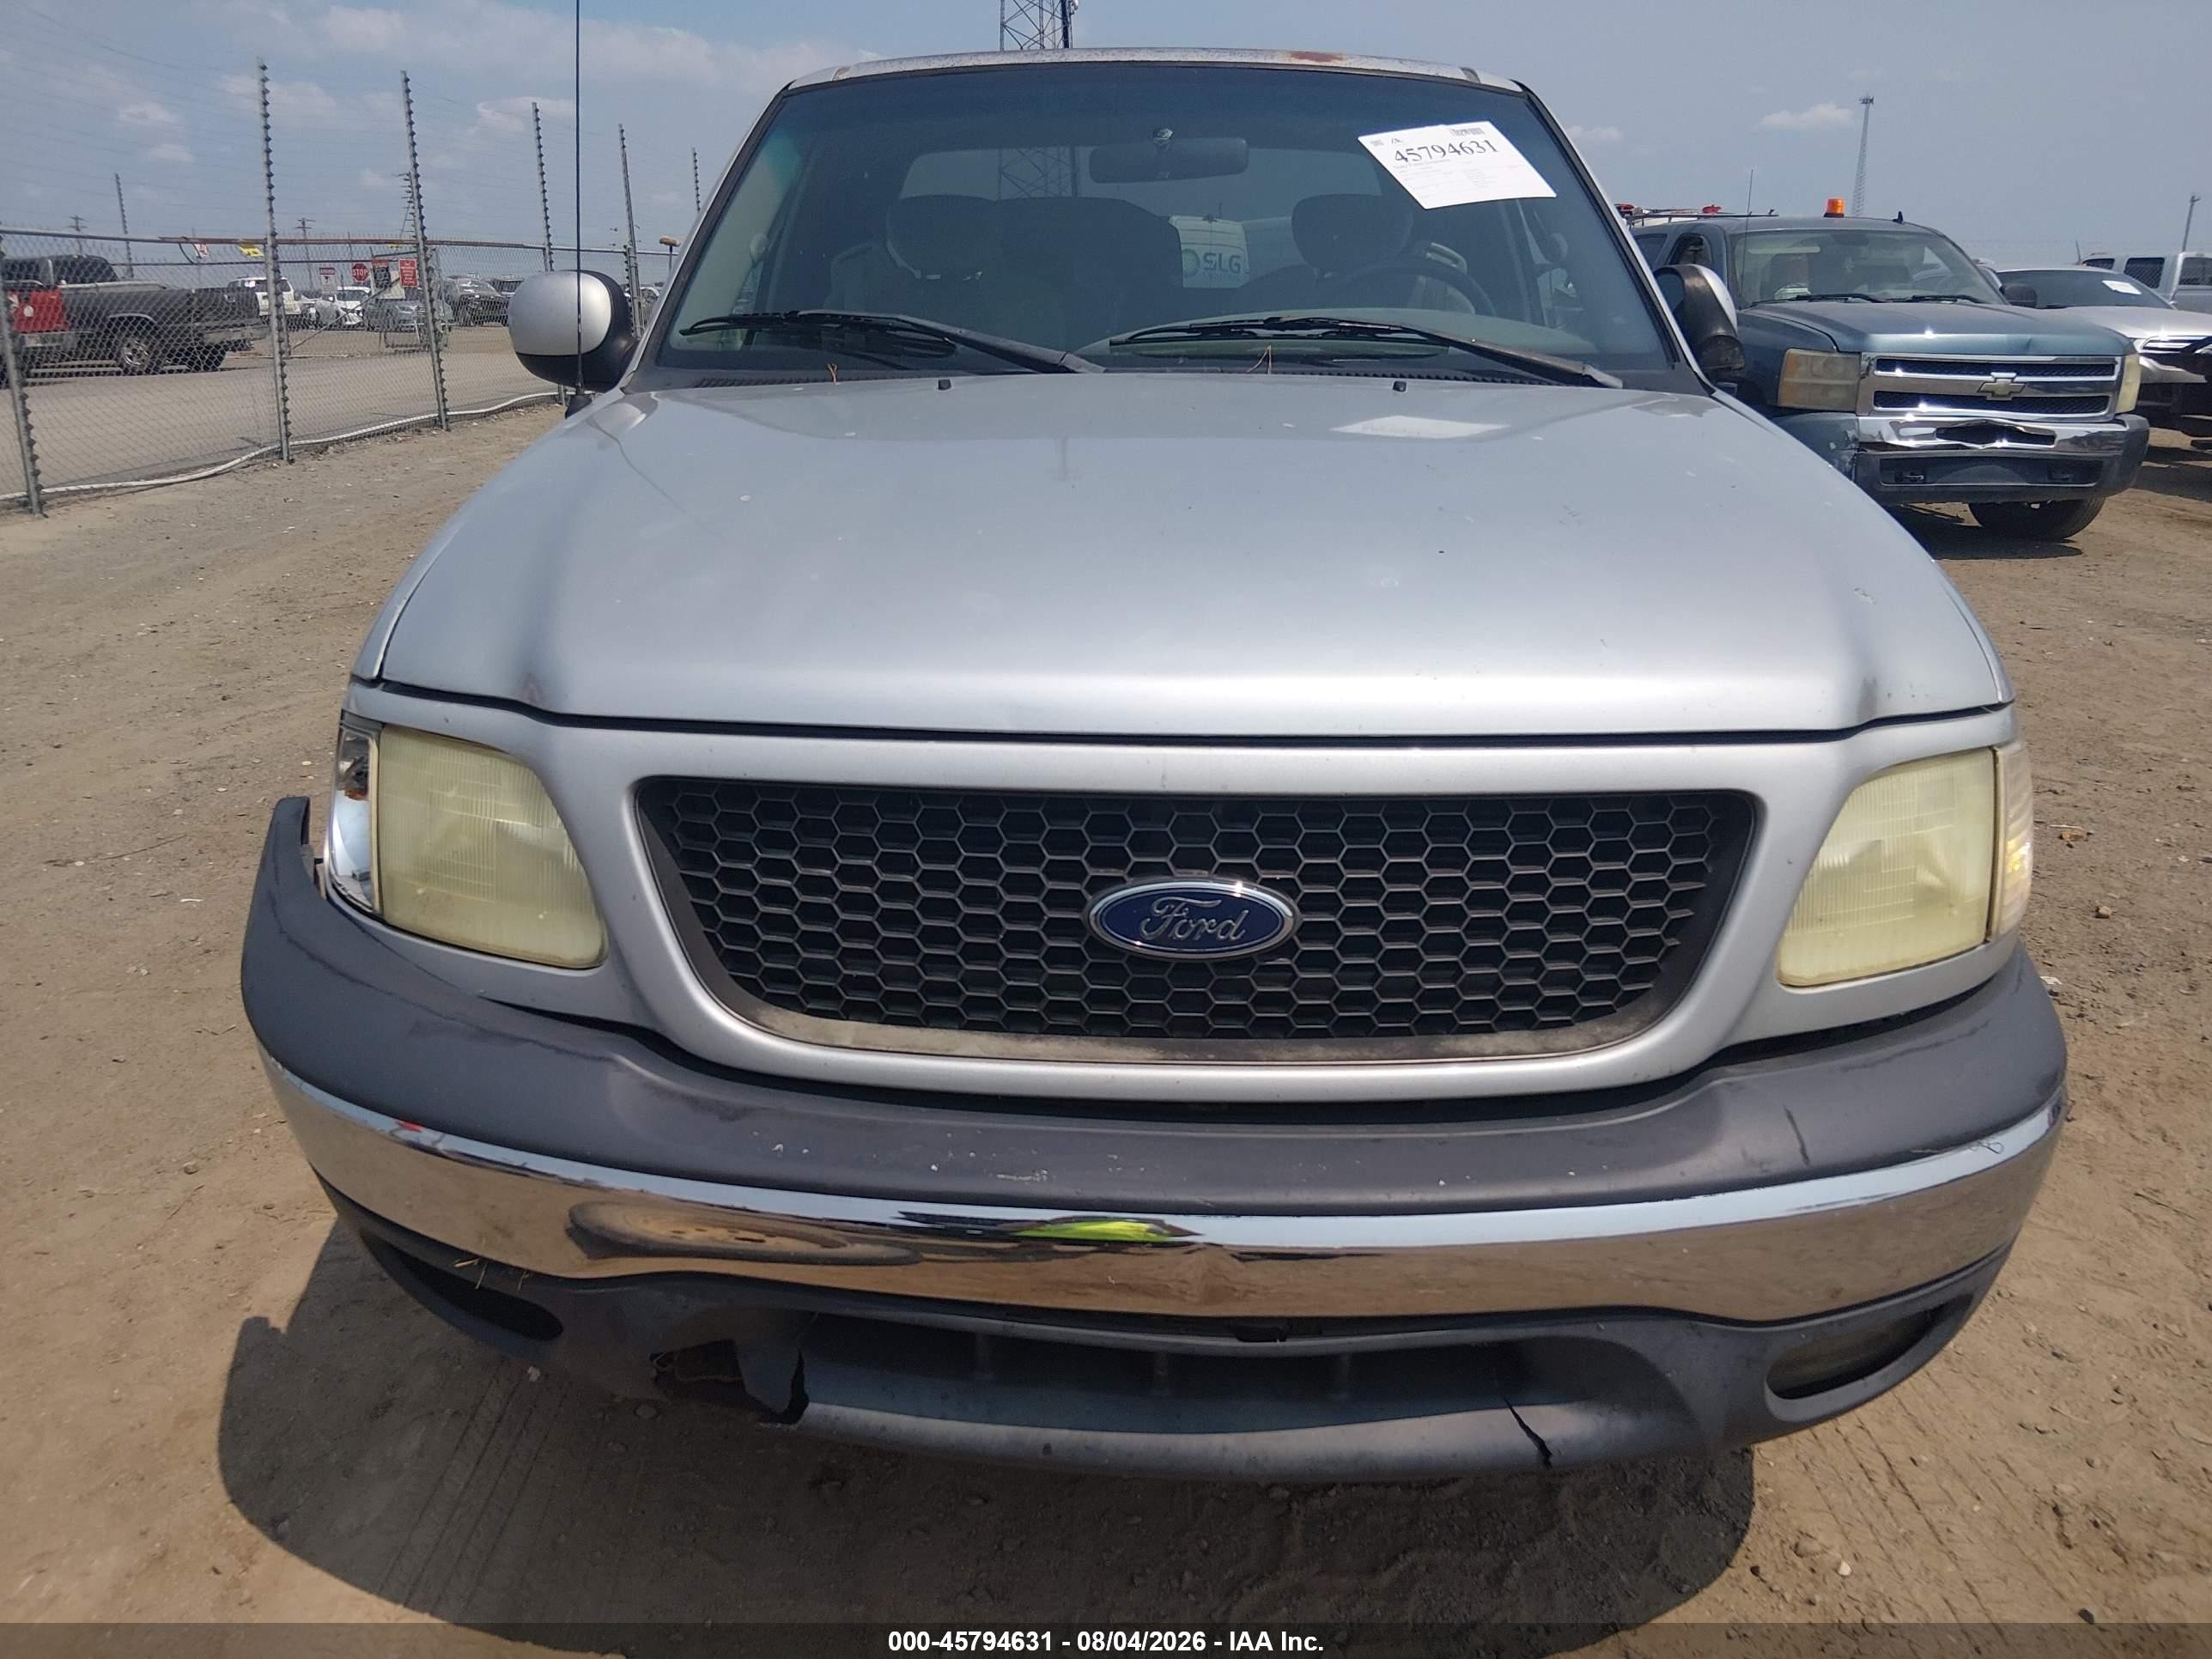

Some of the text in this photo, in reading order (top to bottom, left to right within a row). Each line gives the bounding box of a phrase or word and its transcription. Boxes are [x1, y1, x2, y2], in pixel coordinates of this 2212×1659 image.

[1394, 139, 1498, 162] 45794631
[352, 268, 368, 276] STOP
[1203, 252, 1241, 274] SLG
[1139, 896, 1249, 941] Ford
